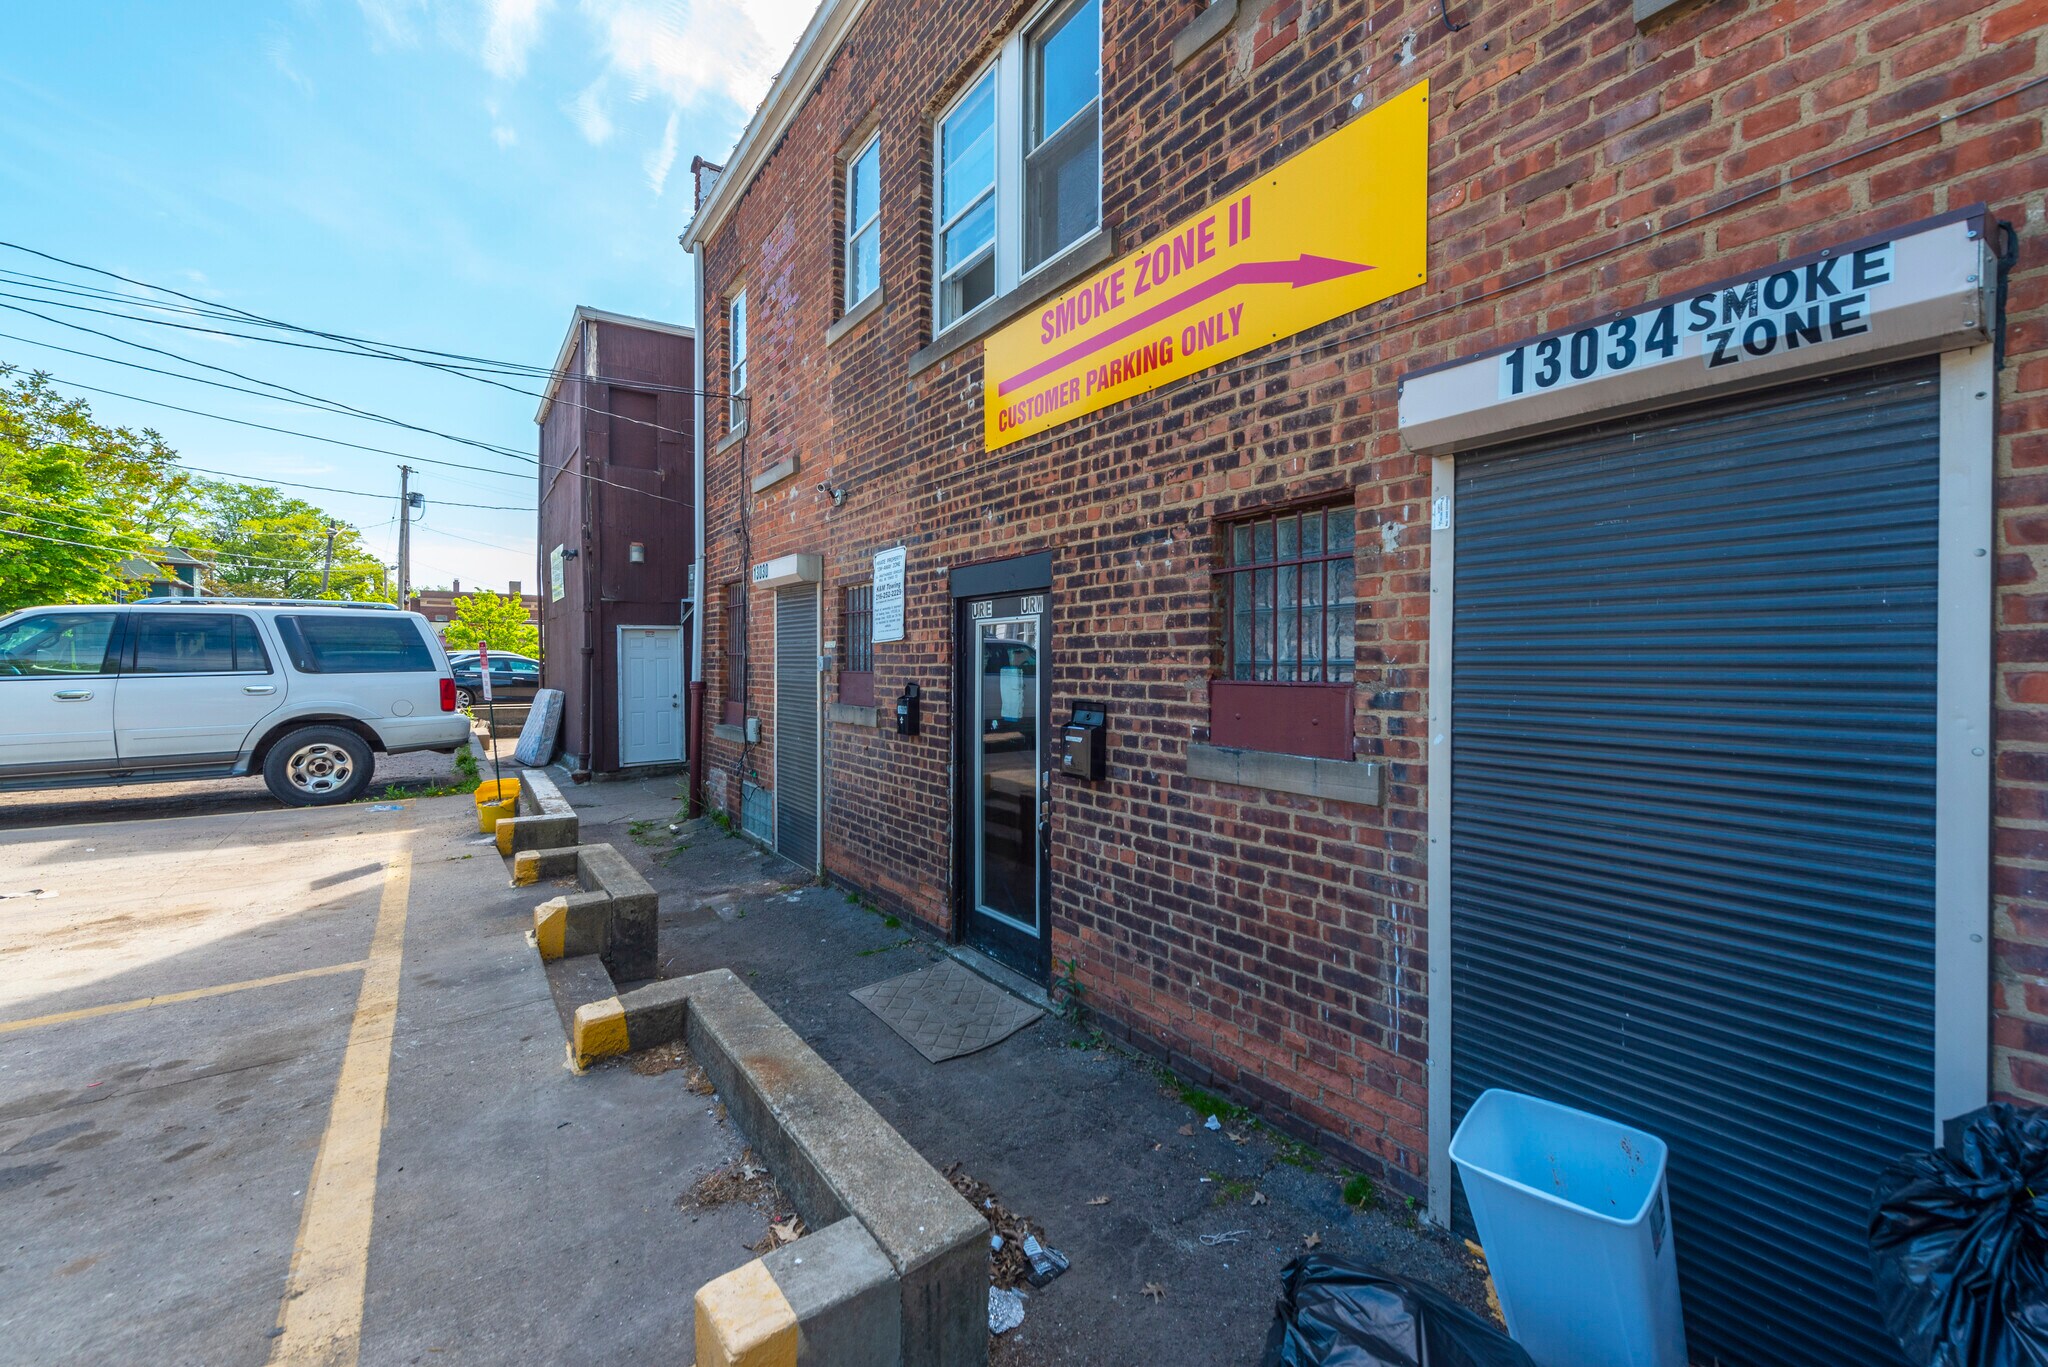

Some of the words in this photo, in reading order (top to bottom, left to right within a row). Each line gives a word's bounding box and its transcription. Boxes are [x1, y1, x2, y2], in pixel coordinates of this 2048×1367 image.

[1041, 268, 1125, 345] SMOKE
[1133, 214, 1216, 298] ZONE
[1229, 195, 1252, 247] II
[1688, 242, 1891, 332] SMOKE
[998, 376, 1080, 432] CUSTOMER
[1086, 336, 1173, 397] PARKING
[1181, 303, 1245, 356] ONLY
[1505, 305, 1679, 395] 13034
[1706, 294, 1868, 369] ZONE
[972, 602, 992, 618] URE
